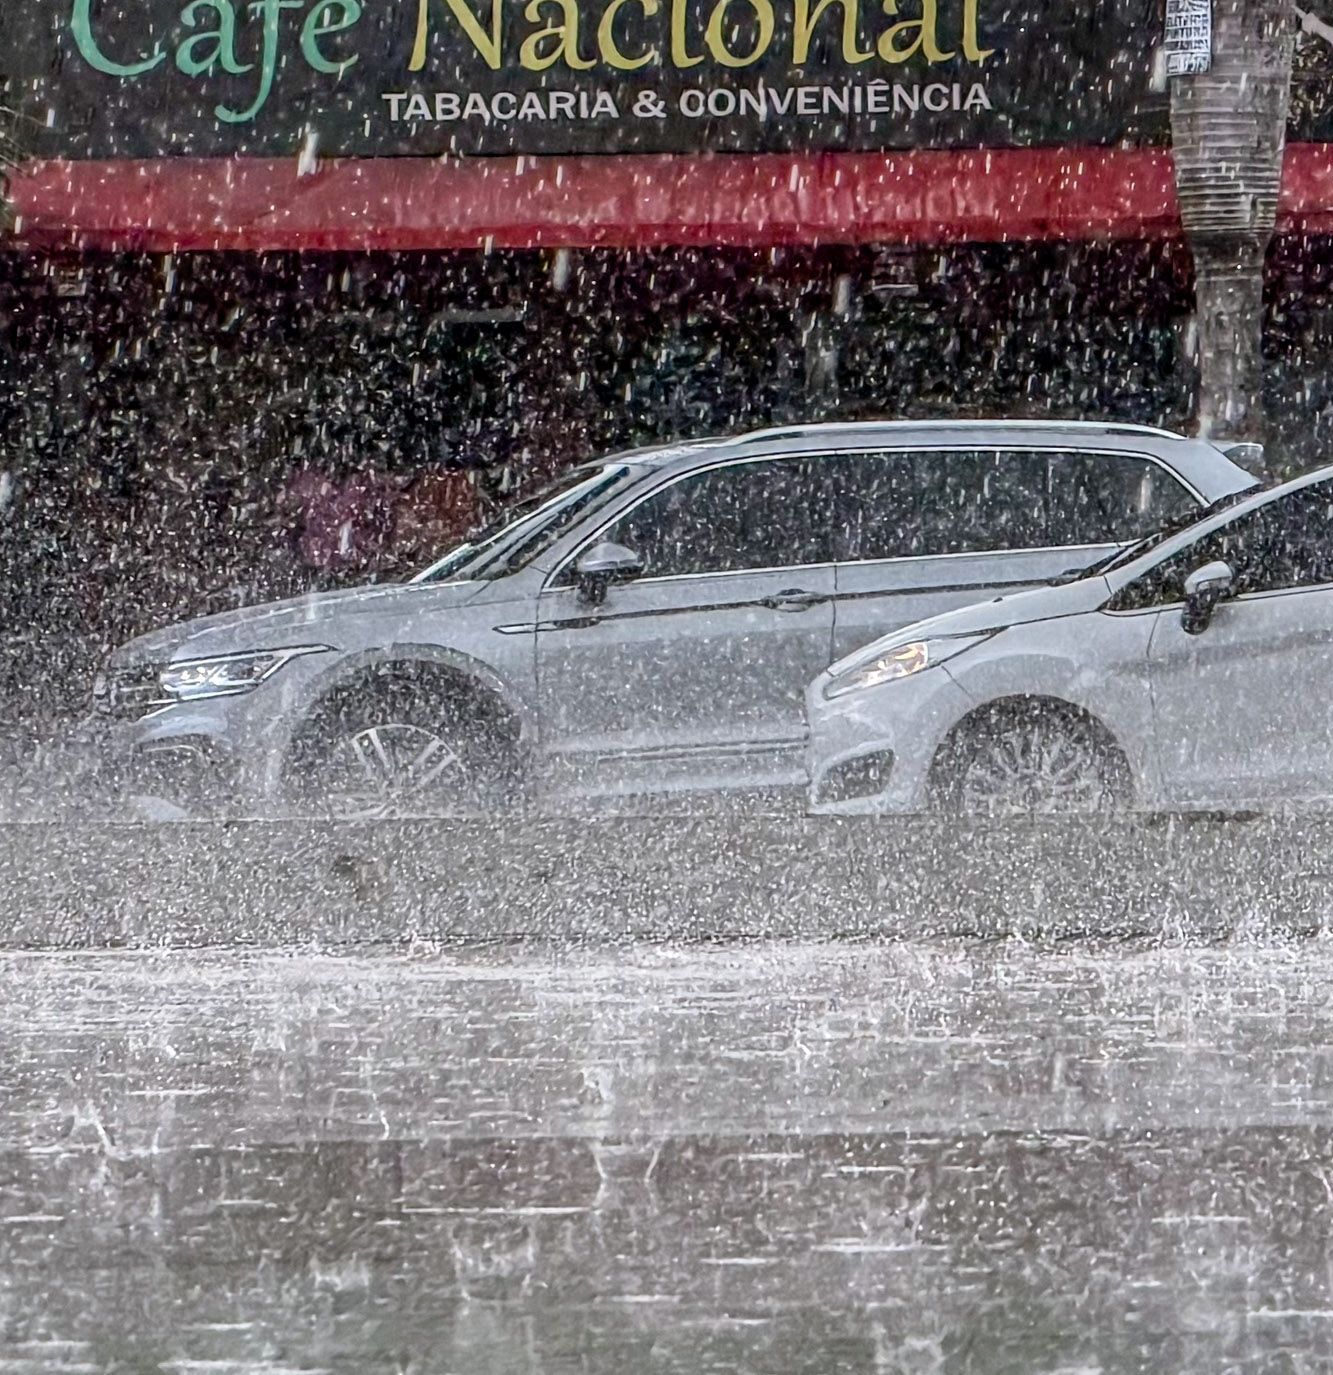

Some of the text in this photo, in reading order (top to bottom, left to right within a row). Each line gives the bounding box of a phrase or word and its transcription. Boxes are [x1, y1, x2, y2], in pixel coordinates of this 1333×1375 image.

[381, 79, 992, 122] TABACARIA & CONVENIÊNCIA
